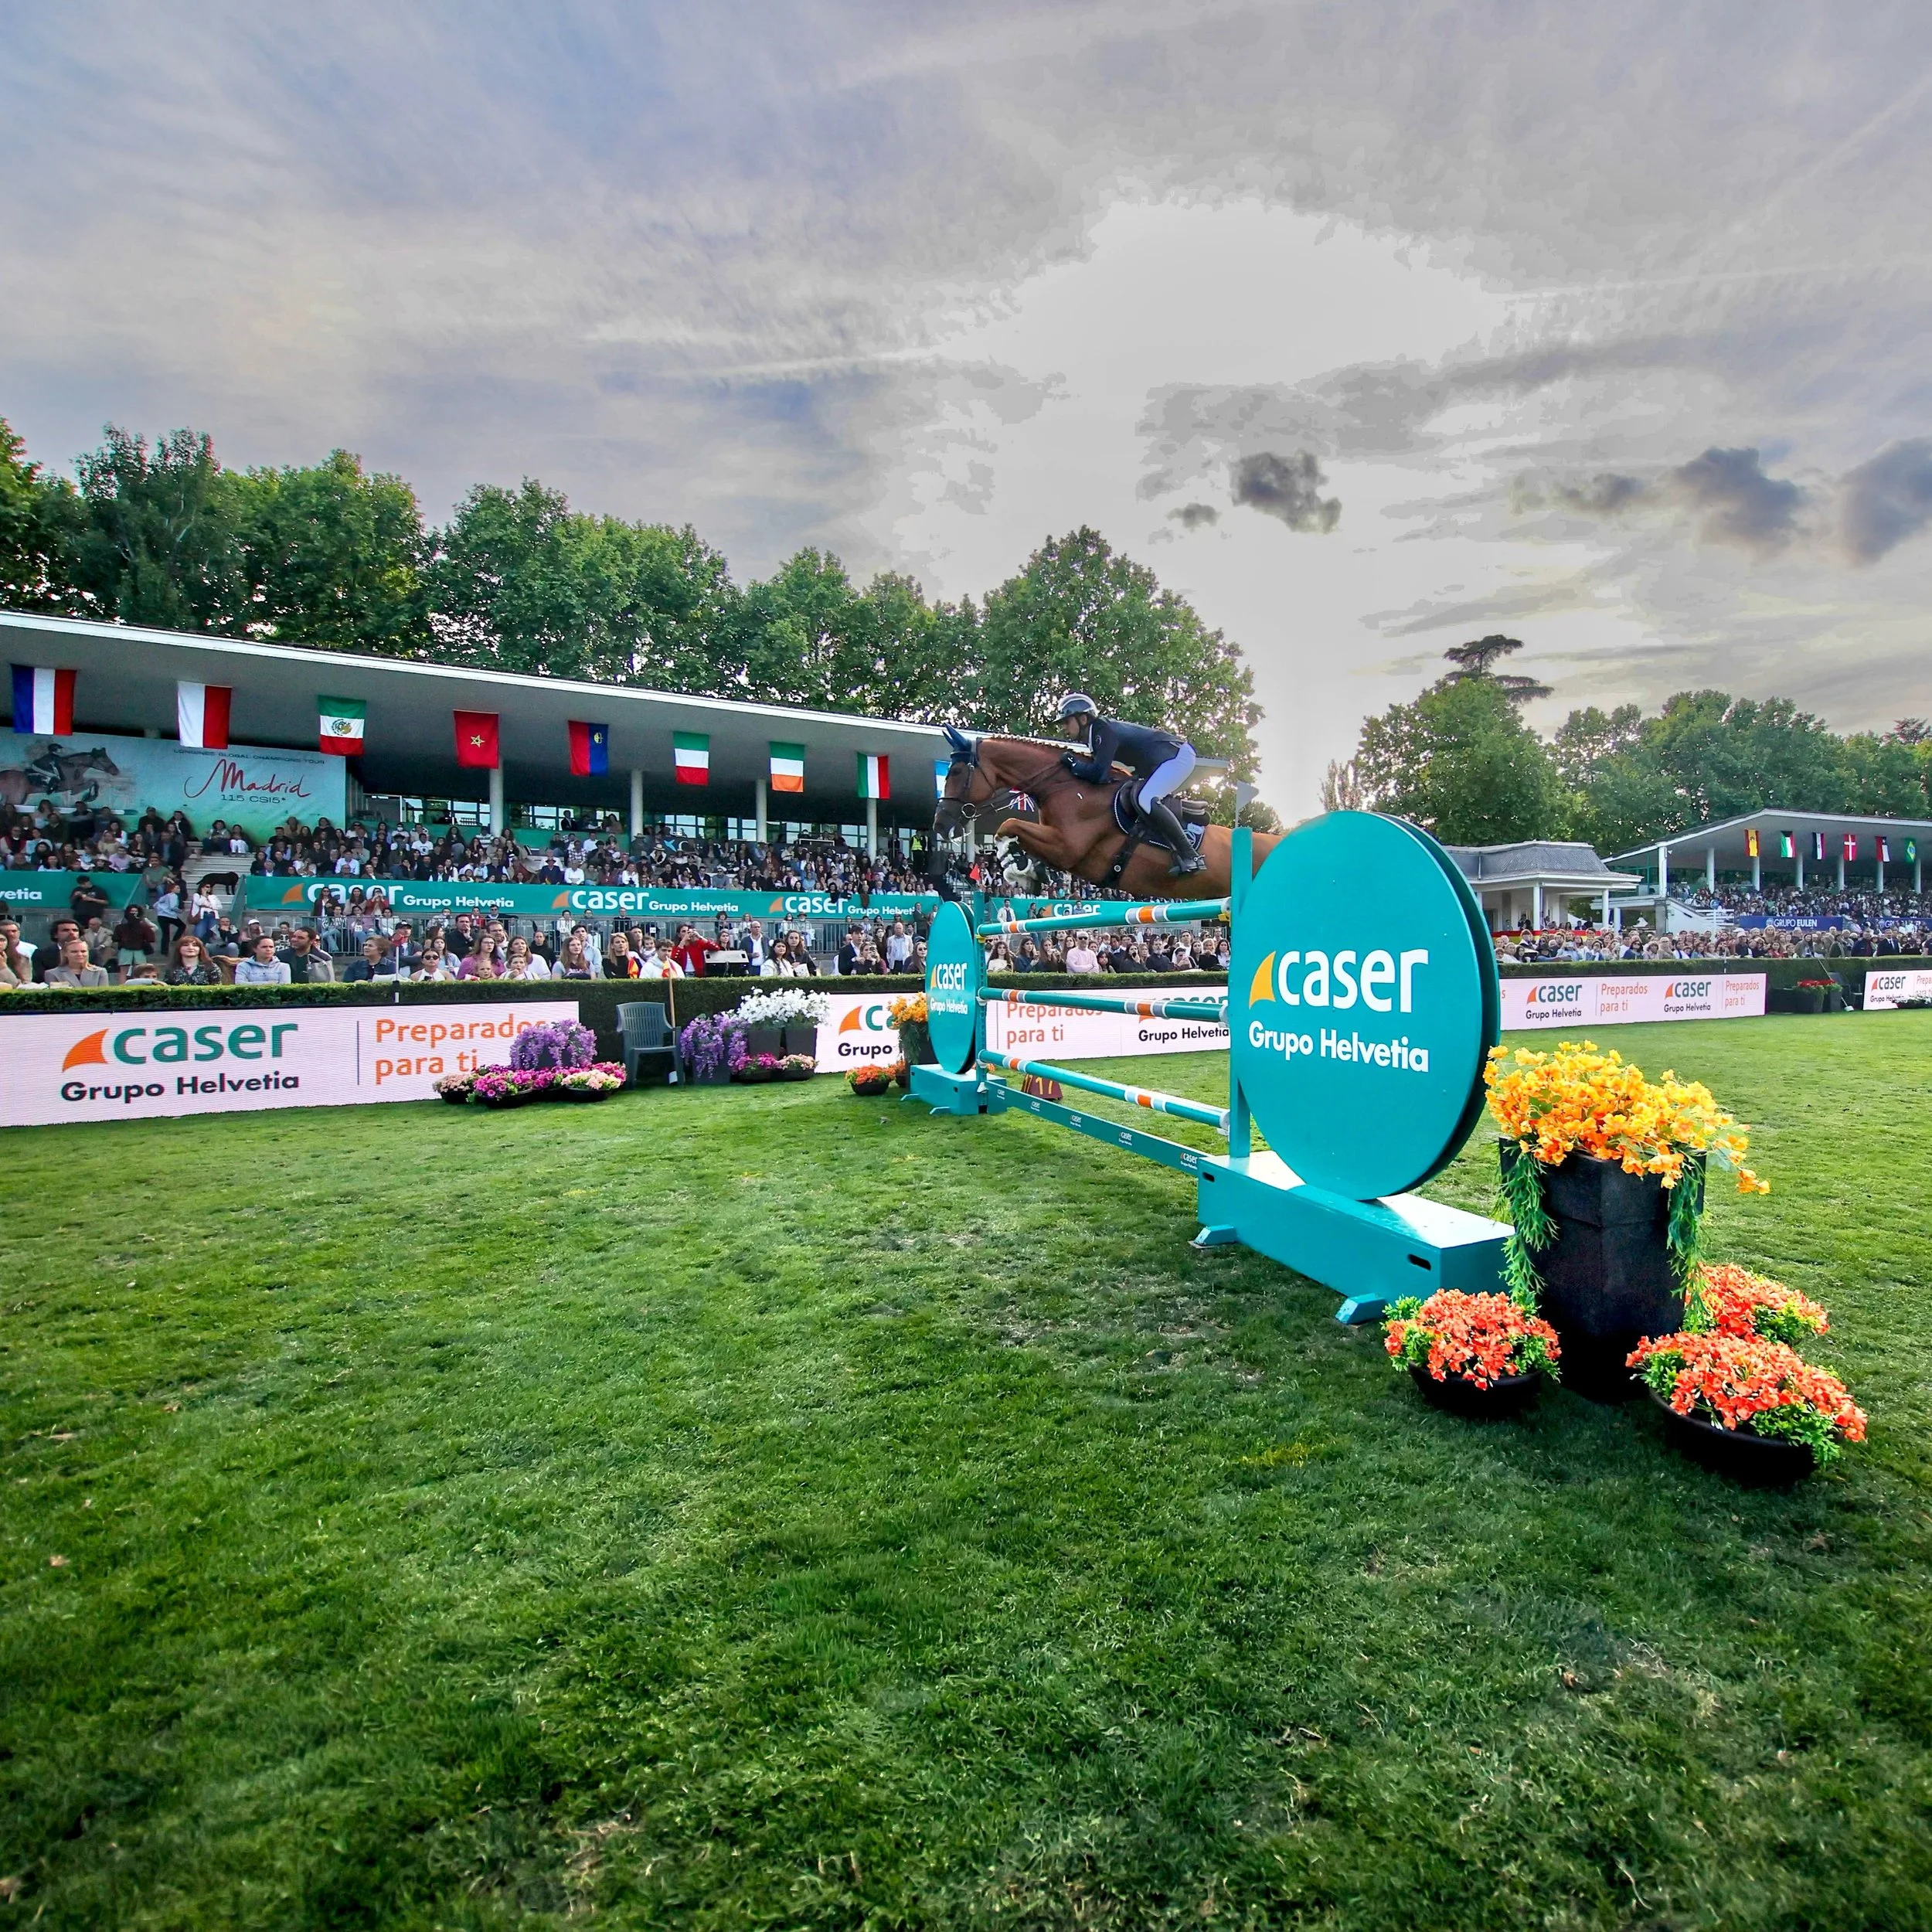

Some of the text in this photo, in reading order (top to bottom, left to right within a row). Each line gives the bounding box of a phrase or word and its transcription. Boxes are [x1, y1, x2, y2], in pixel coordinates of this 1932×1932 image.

[184, 759, 311, 798] Madrid
[403, 894, 452, 909] Grupo
[455, 895, 515, 908] Helvetia
[572, 889, 739, 913] caser Grupo Helvetia
[784, 896, 915, 917] caser Grupo Helvet
[1053, 903, 1100, 917] caer
[1774, 919, 1818, 927] GRUPO EULEN
[937, 963, 968, 991] caser
[1277, 948, 1429, 1013] caser
[1879, 976, 1906, 990] caser
[1539, 984, 1582, 1003] caser
[1601, 981, 1648, 998] Preparados
[1675, 981, 1712, 998] caser
[1726, 978, 1760, 995] Preparados
[930, 998, 968, 1015] Grupo Helvetia
[1600, 999, 1628, 1016] para ti
[1664, 1002, 1711, 1014] Grupo Helvetia
[1725, 998, 1739, 1010] para
[1870, 995, 1885, 1004] Grupo
[1526, 1008, 1582, 1021] Grupo Helvetia
[1007, 1024, 1063, 1049] para ti
[1138, 1026, 1230, 1044] Grupo Helvetia
[113, 1023, 298, 1065] caser
[838, 1043, 893, 1060] Grupo
[1249, 1020, 1429, 1073] Grupo Helvetia
[376, 1049, 478, 1085] para ti
[61, 1070, 299, 1104] Grupo Helvetia
[1183, 1153, 1198, 1165] caser
